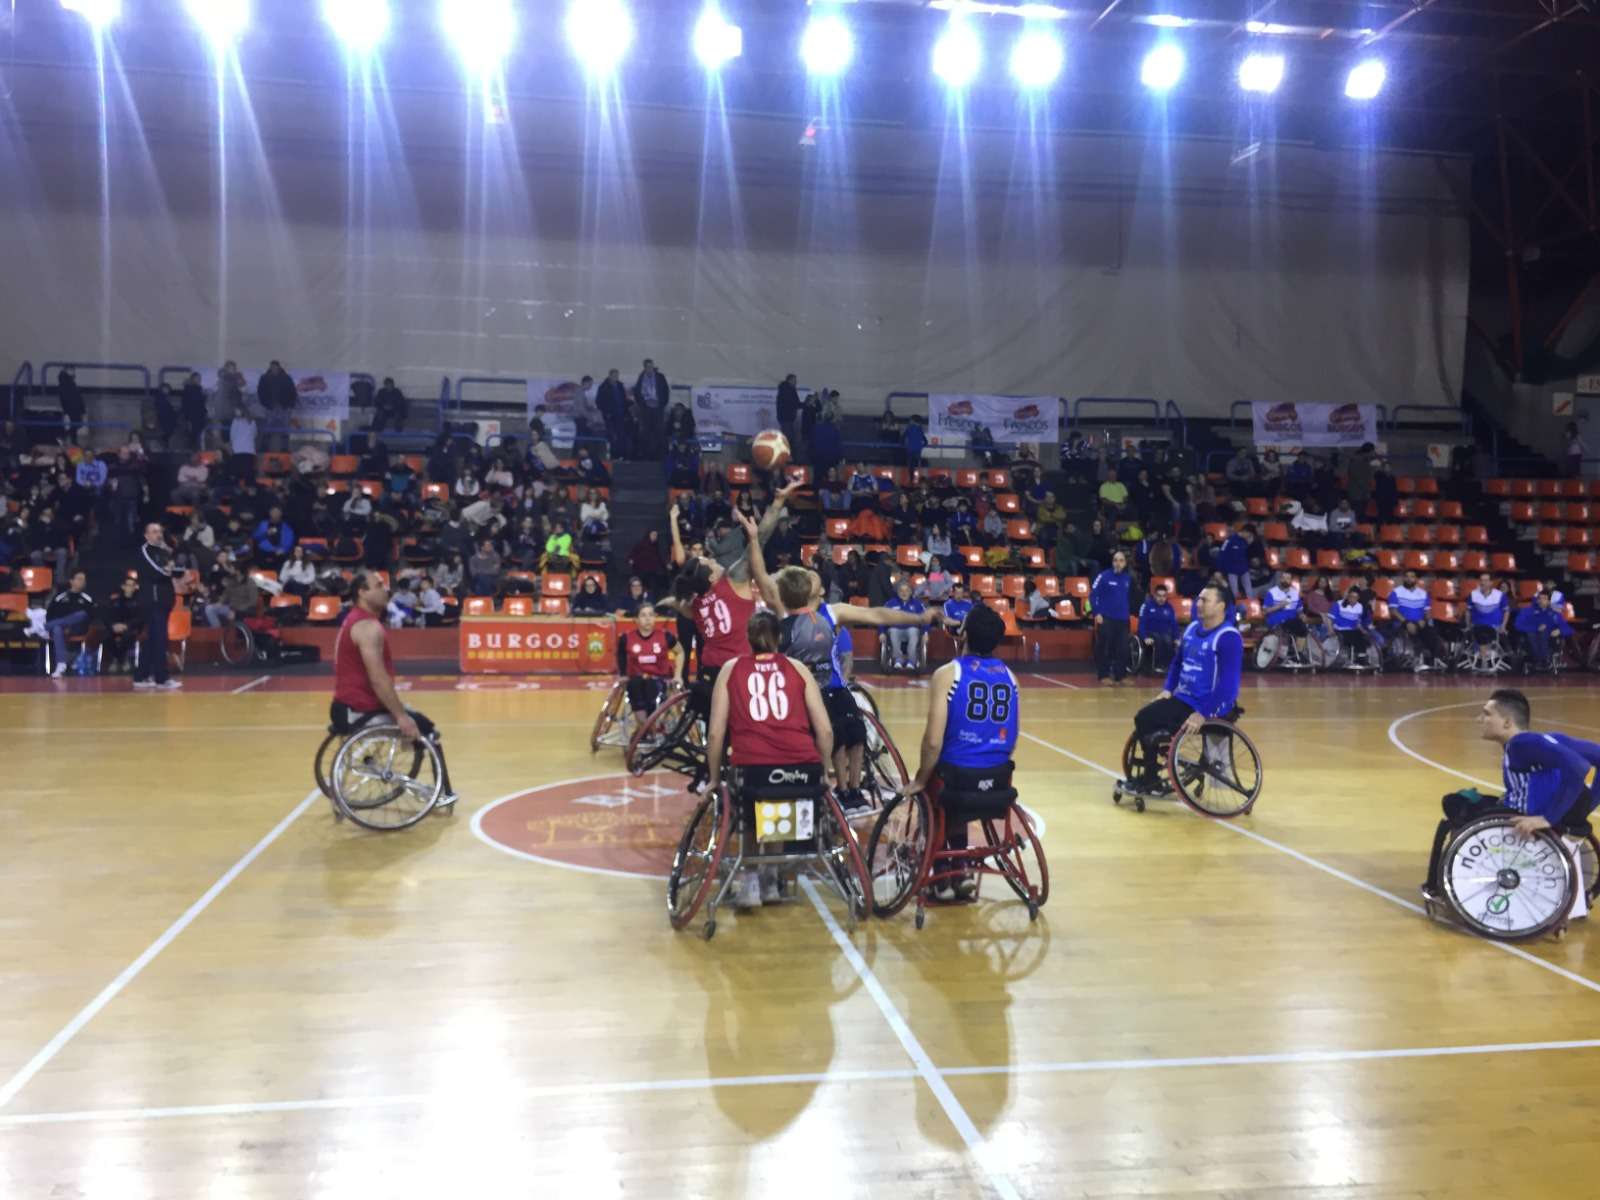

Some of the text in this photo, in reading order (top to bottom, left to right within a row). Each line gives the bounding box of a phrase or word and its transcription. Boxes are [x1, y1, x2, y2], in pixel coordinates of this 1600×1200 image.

[699, 599, 733, 638] 59
[467, 633, 580, 649] BURGOS
[747, 671, 789, 722] 86
[966, 680, 1013, 724] 88
